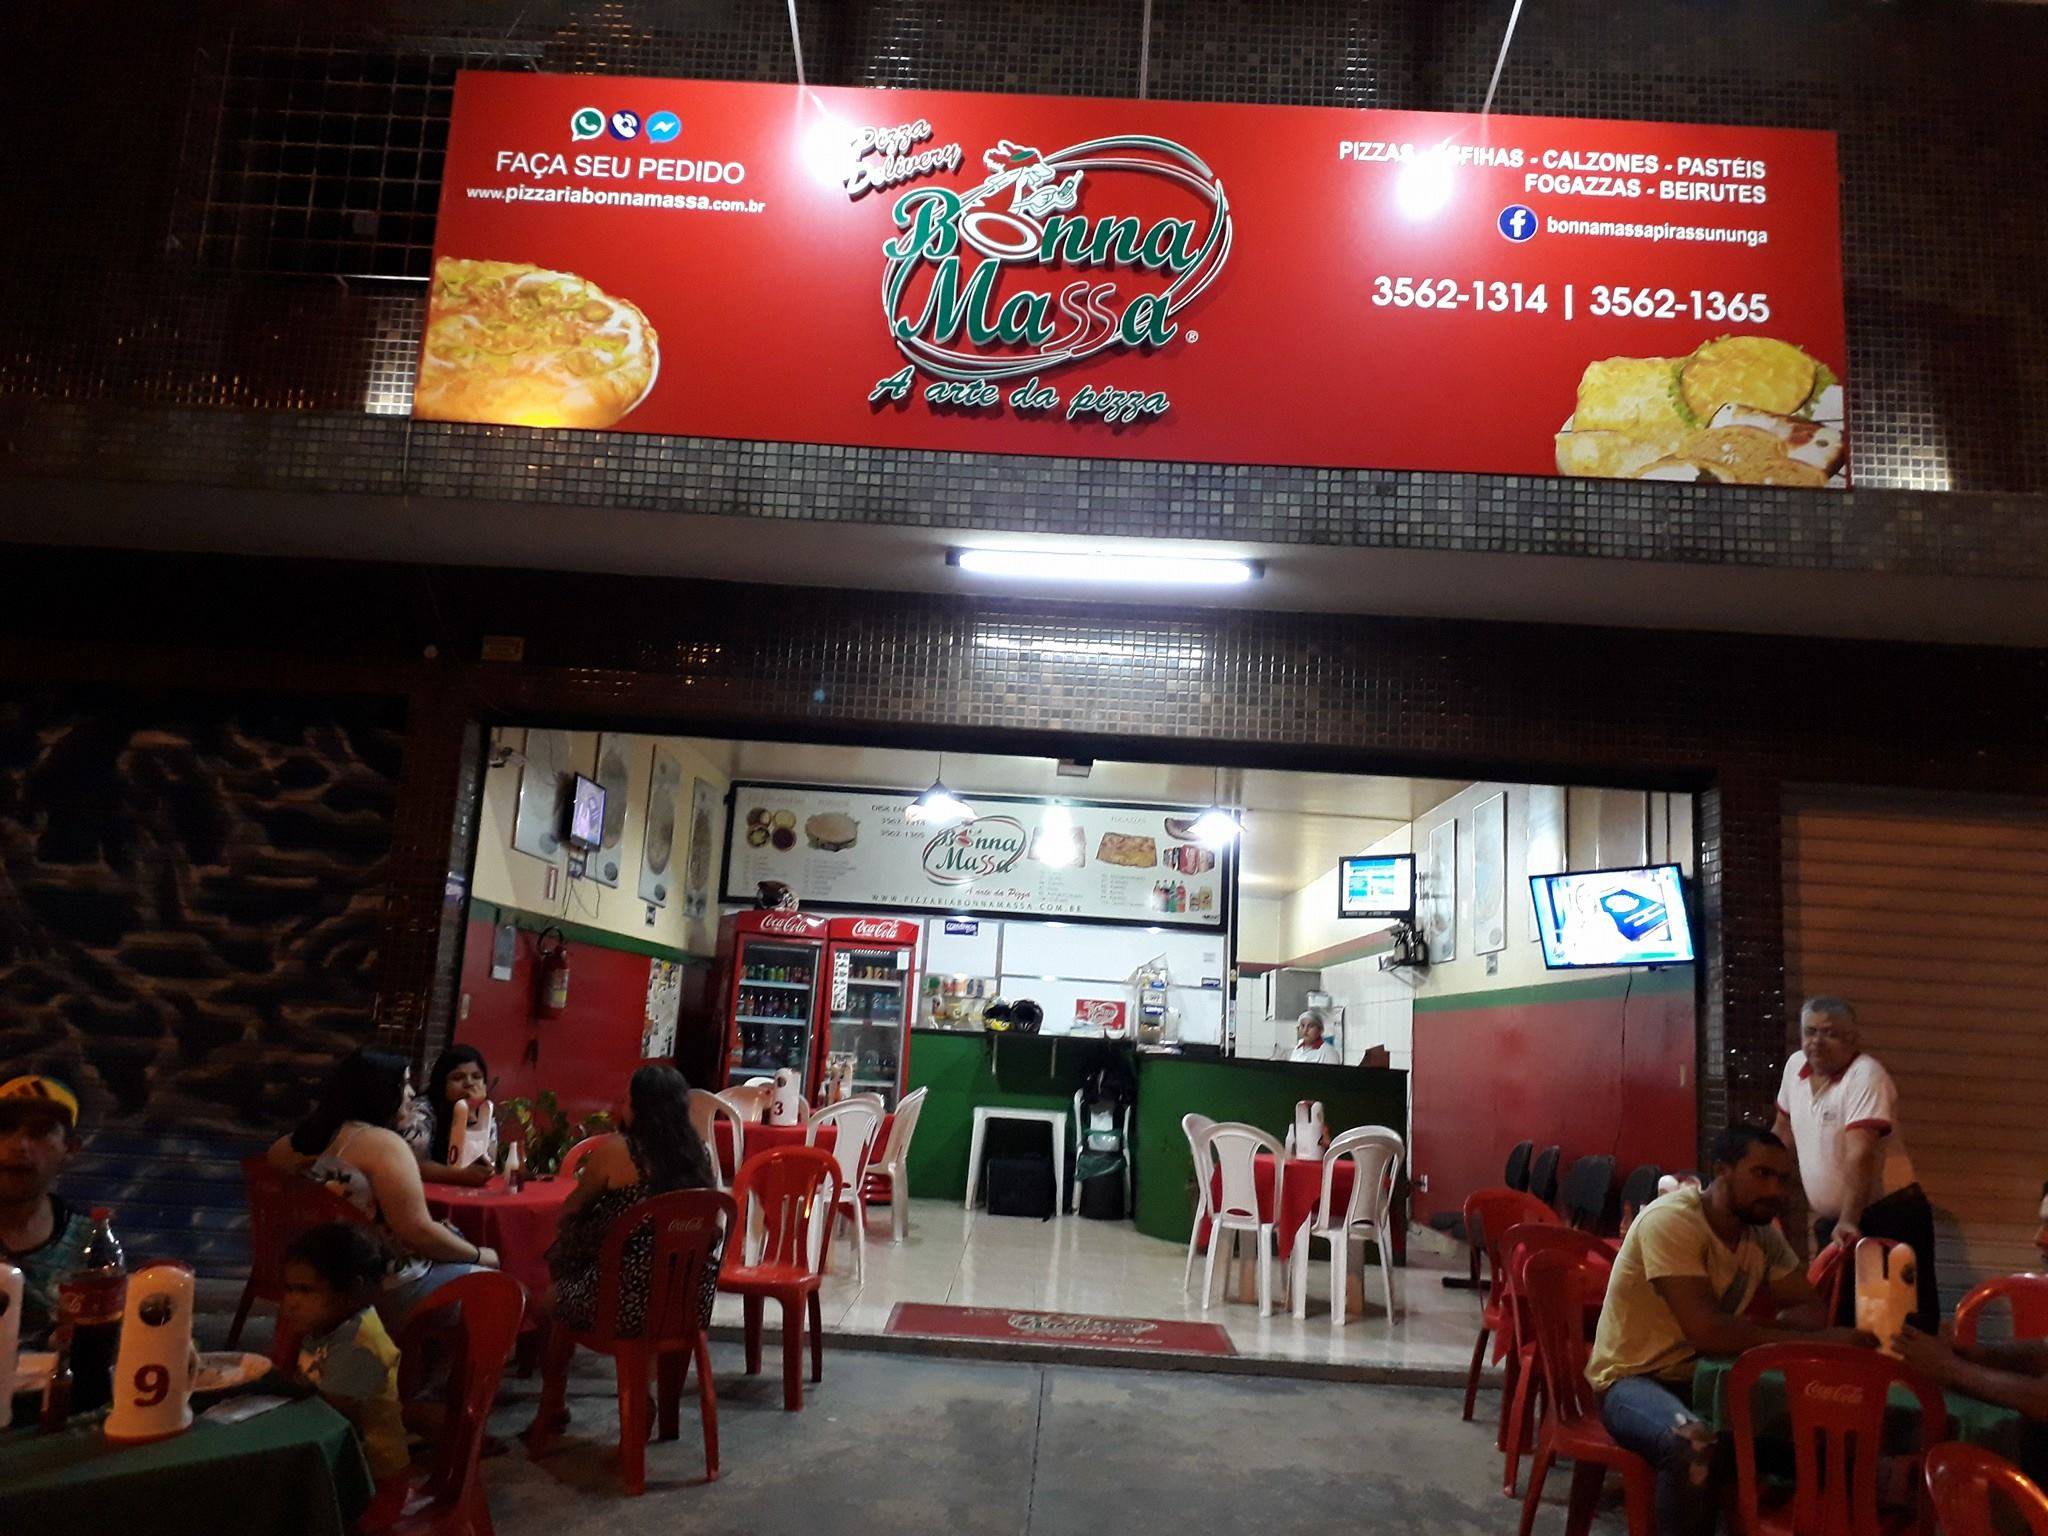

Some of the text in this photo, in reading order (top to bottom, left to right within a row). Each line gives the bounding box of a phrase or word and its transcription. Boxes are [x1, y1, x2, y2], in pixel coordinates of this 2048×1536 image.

[849, 118, 932, 162] Pizza
[495, 150, 746, 185] FAÇA SEU PEDIDO
[843, 143, 962, 197] Delivery
[1339, 141, 1415, 162] PIZZAS
[1543, 149, 1659, 174] CALZONES
[1676, 156, 1766, 180] PASTÉIS
[466, 184, 766, 214] www.pizzariabonnamassa.com.br
[1524, 174, 1641, 198] FOGAZZAS
[1659, 180, 1767, 204] BEIRUTES
[1546, 216, 1769, 245] bonnamassapirassununga
[897, 256, 1178, 357] Massa
[1371, 275, 1548, 314] 3562-1314
[1589, 286, 1771, 324] 3562-1365
[868, 365, 1170, 423] A arte da pizza
[773, 1101, 784, 1116] 3
[133, 1365, 170, 1407] 9
